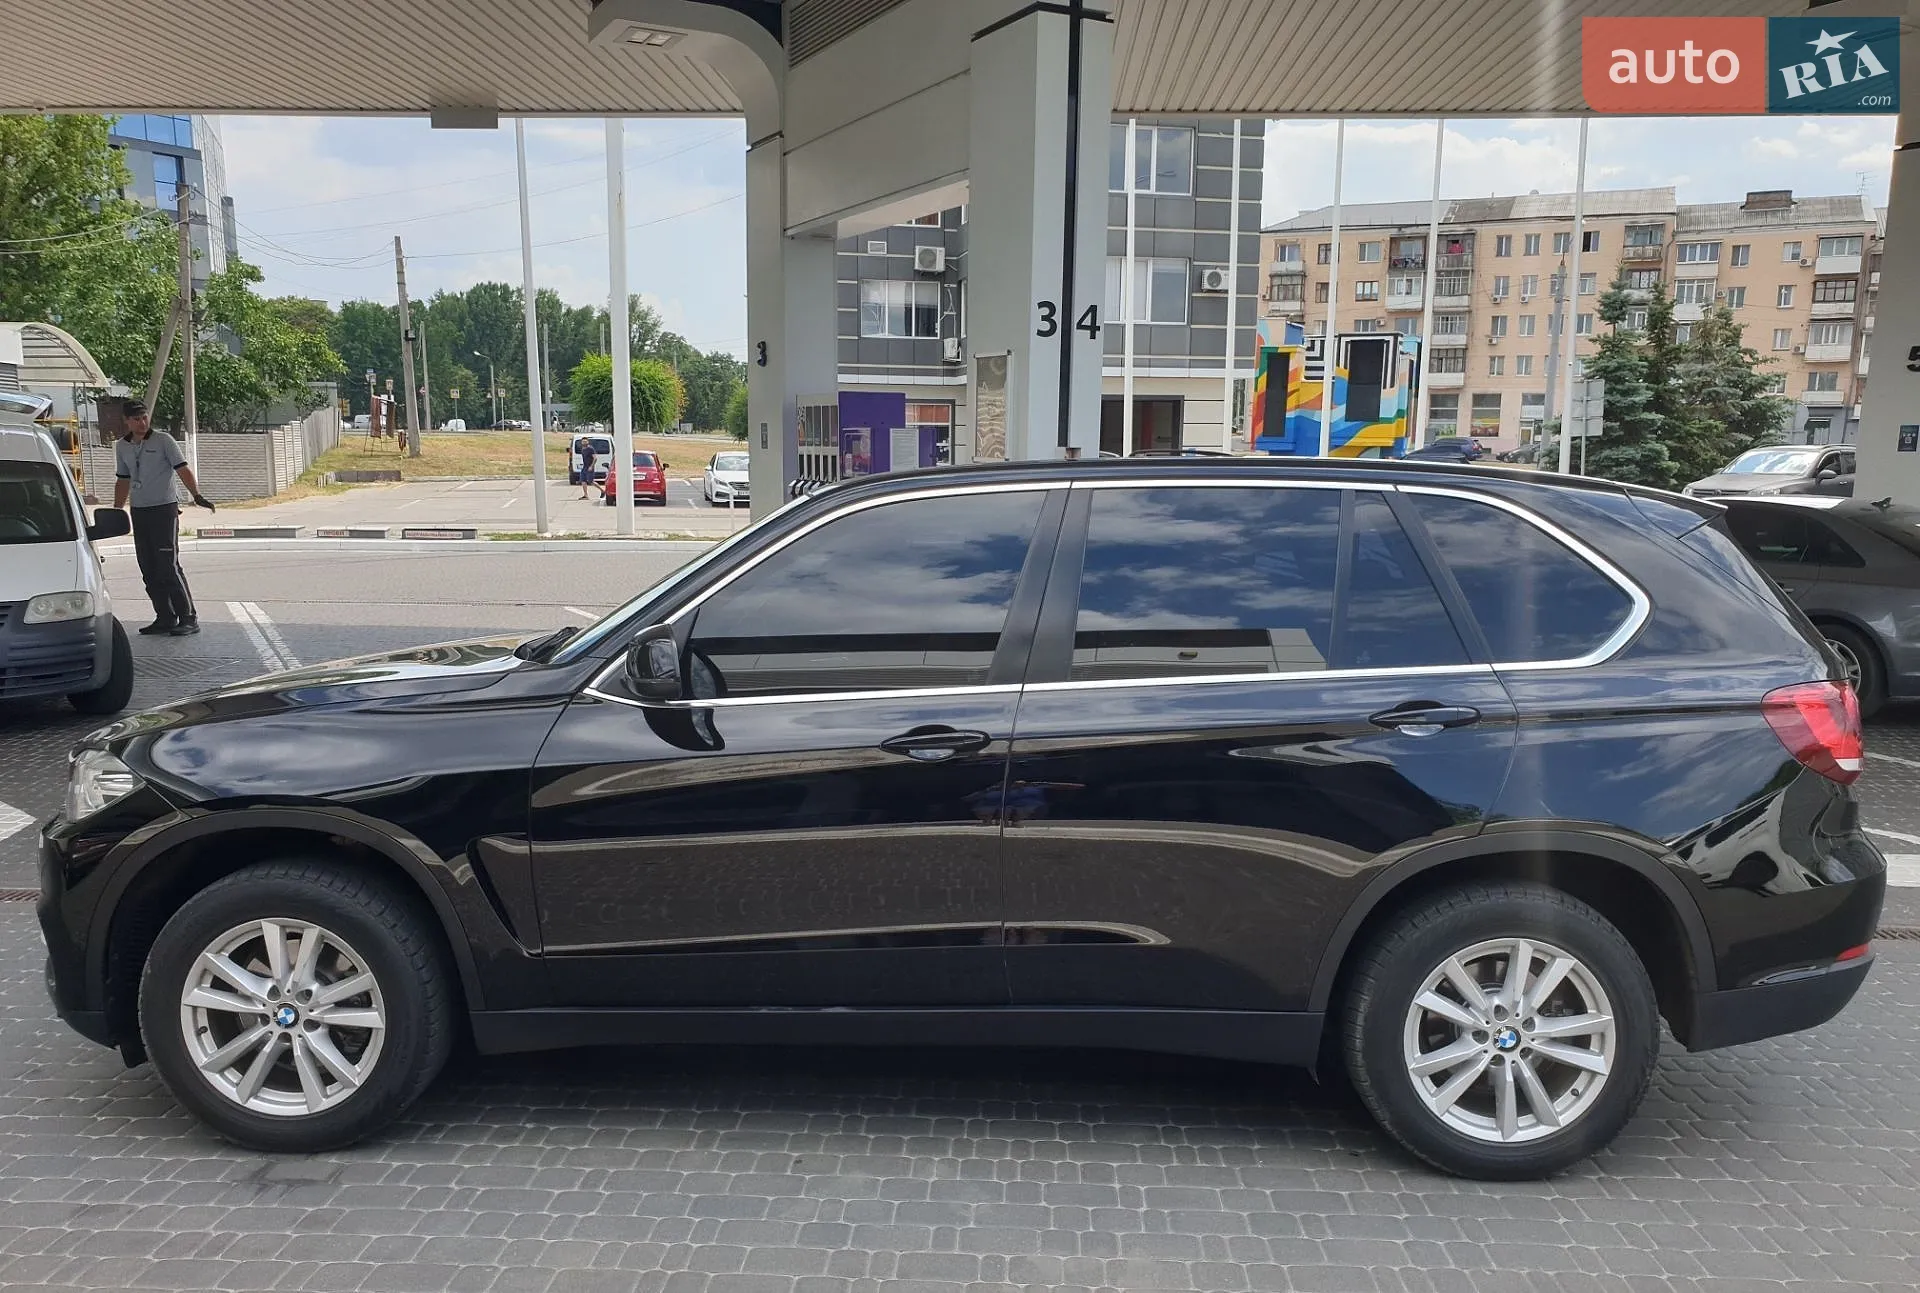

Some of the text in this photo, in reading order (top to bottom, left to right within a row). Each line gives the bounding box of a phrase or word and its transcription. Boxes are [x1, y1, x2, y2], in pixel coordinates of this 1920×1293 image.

[1036, 300, 1058, 338] 3
[1076, 304, 1101, 340] 4
[756, 341, 767, 367] 3
